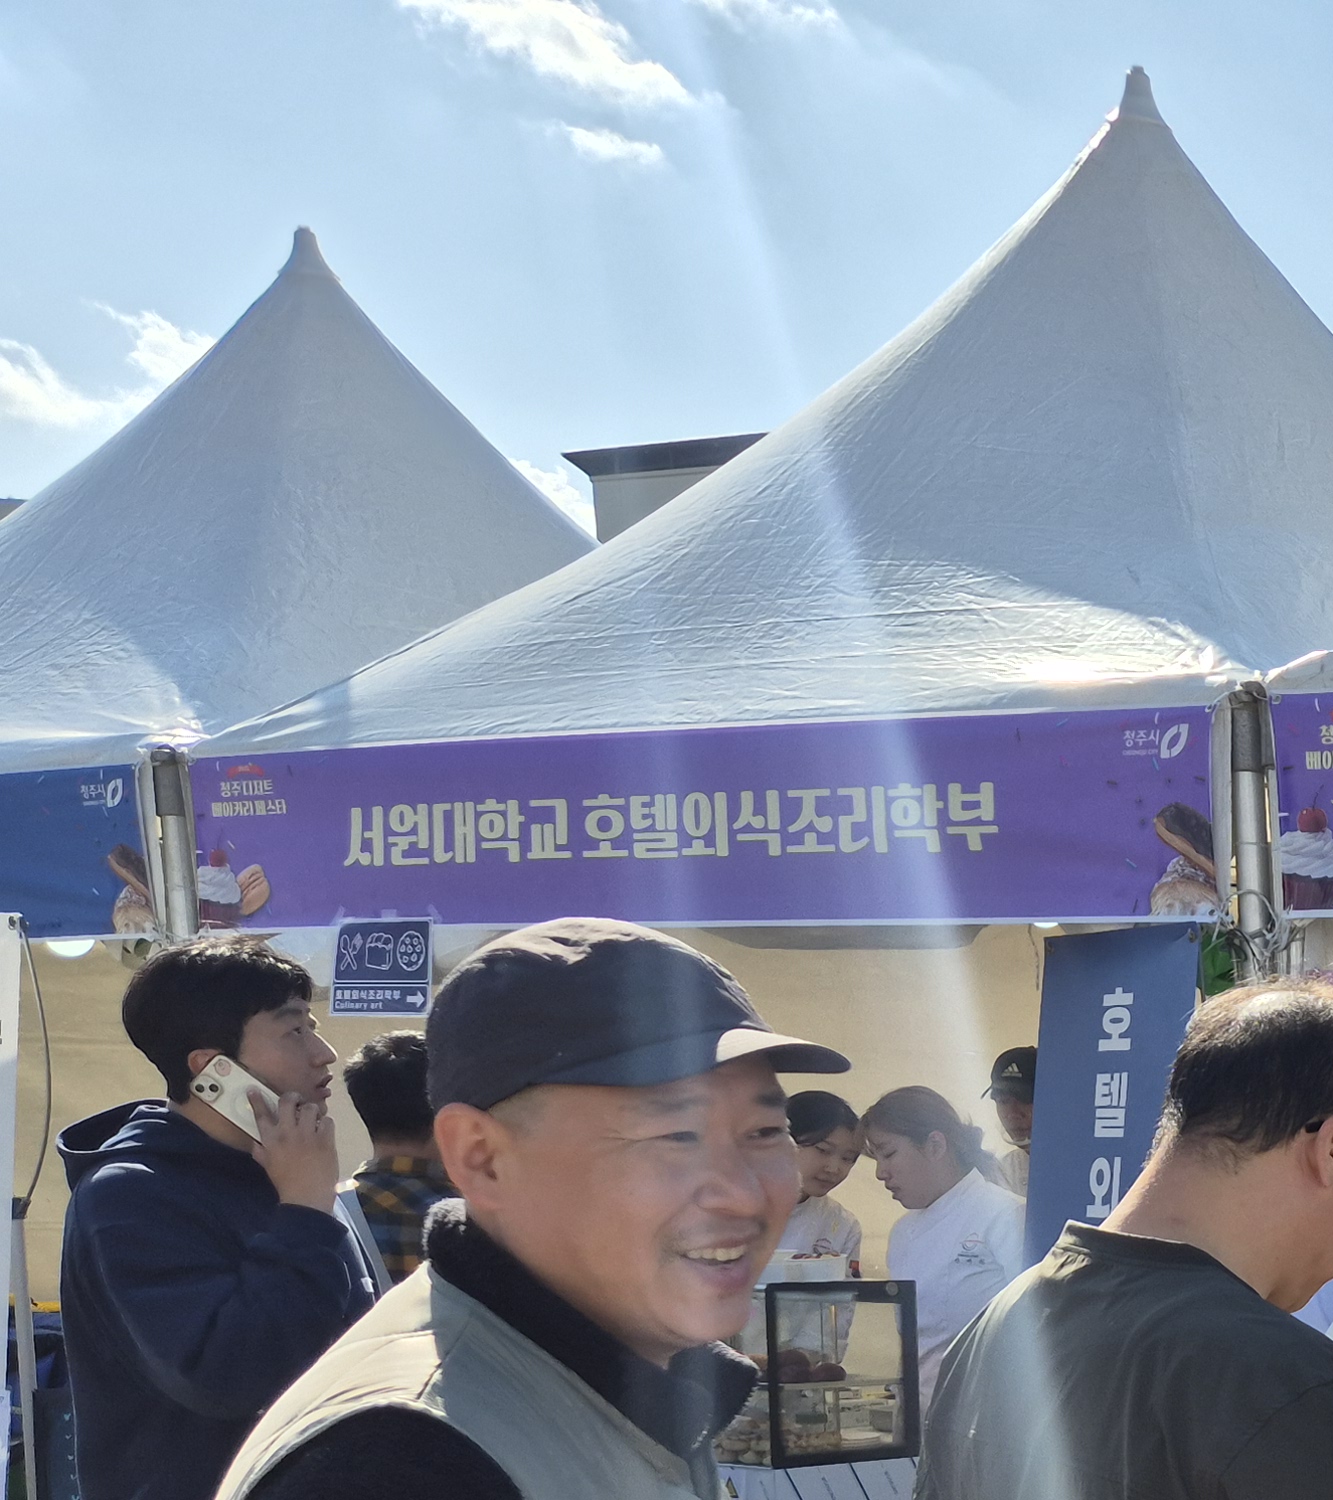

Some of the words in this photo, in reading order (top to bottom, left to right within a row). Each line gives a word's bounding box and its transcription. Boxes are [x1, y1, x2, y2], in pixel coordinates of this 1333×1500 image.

[1123, 728, 1160, 747] 청주시
[343, 797, 569, 869] 서원대학교
[582, 778, 1000, 861] 호텔외식조리학부
[334, 1000, 368, 1010] Culinary
[370, 1001, 383, 1010] art
